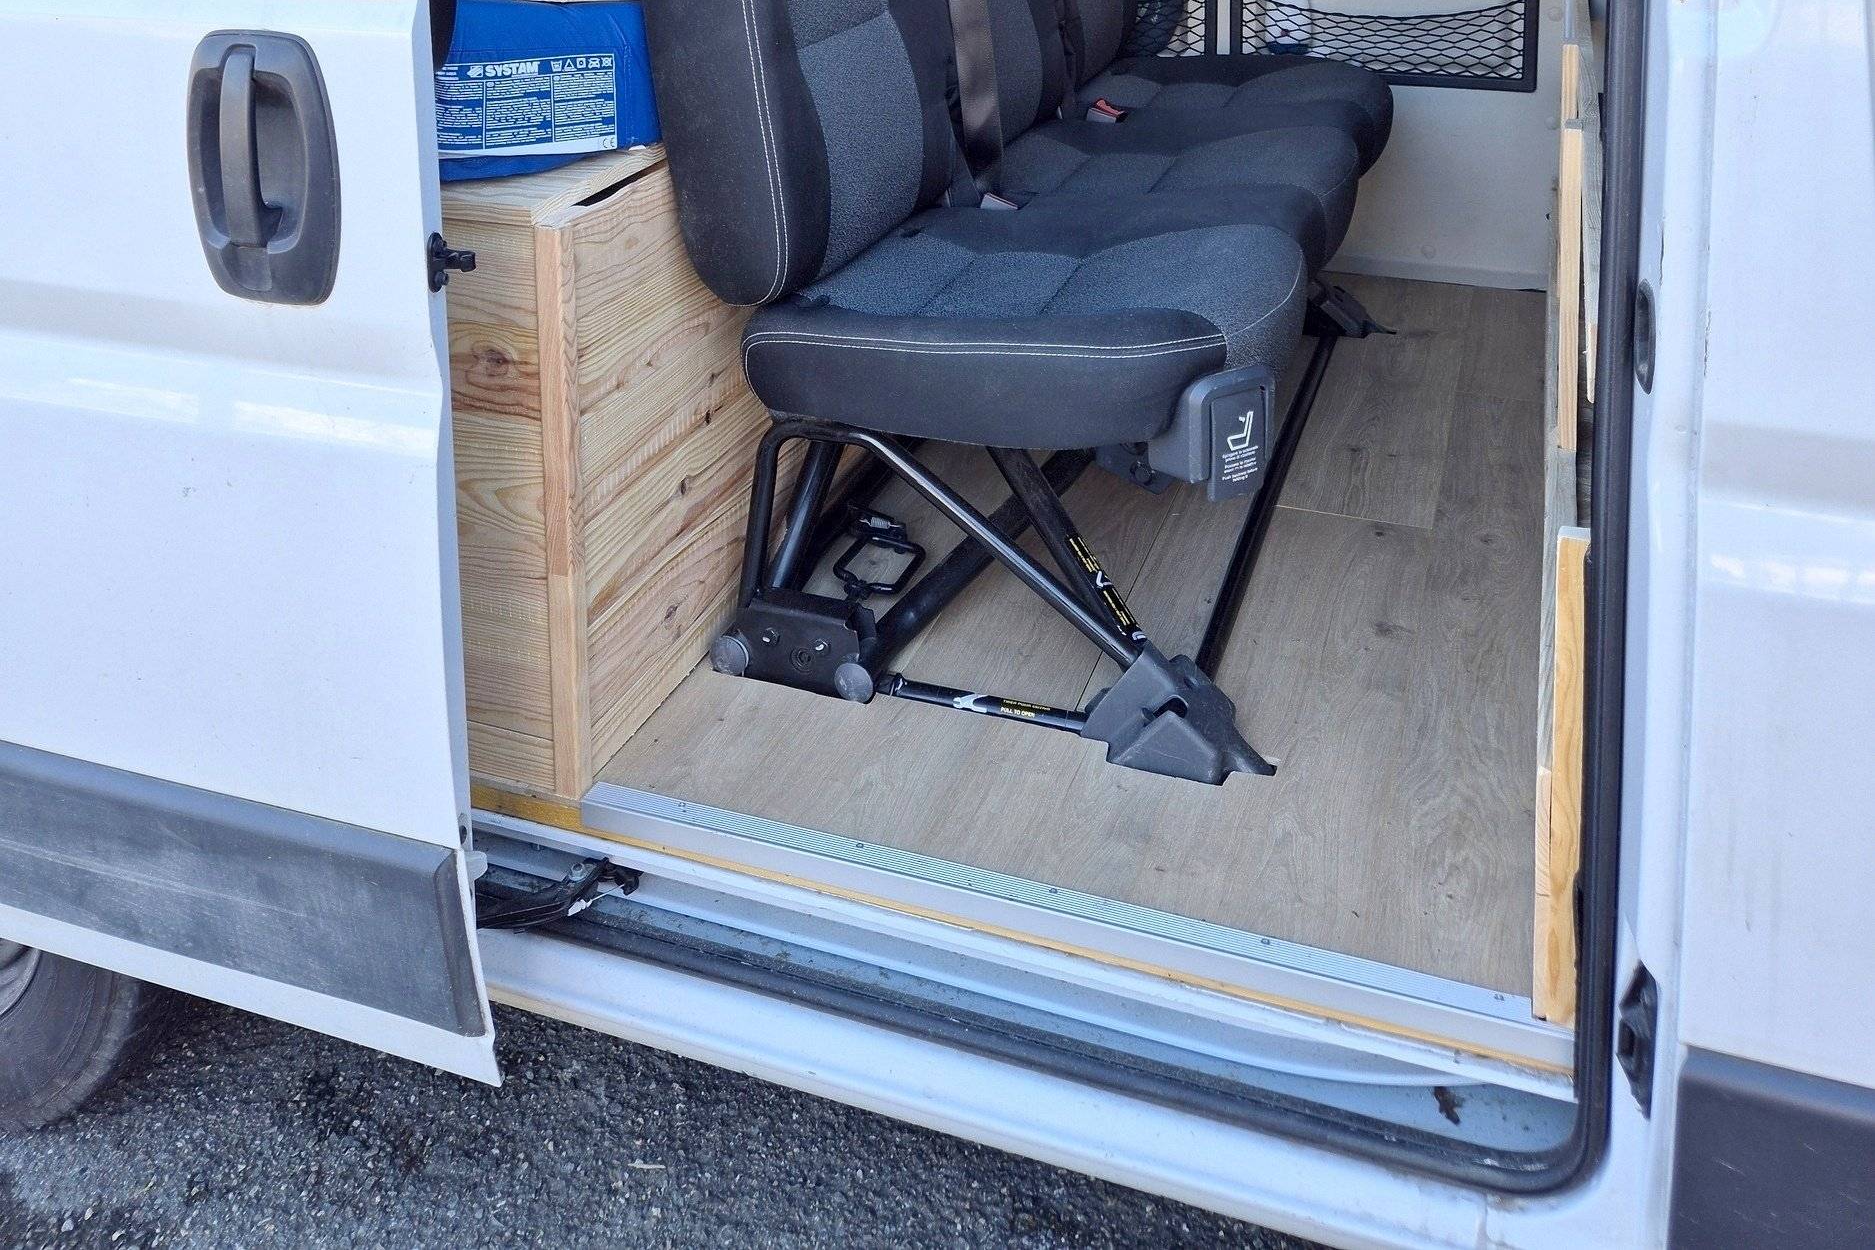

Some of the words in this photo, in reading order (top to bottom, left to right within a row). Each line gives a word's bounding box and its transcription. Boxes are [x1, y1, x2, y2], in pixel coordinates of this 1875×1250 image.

[485, 62, 539, 77] SYSTAM
[1000, 706, 1013, 714] PULL
[1021, 710, 1035, 718] OPEN
